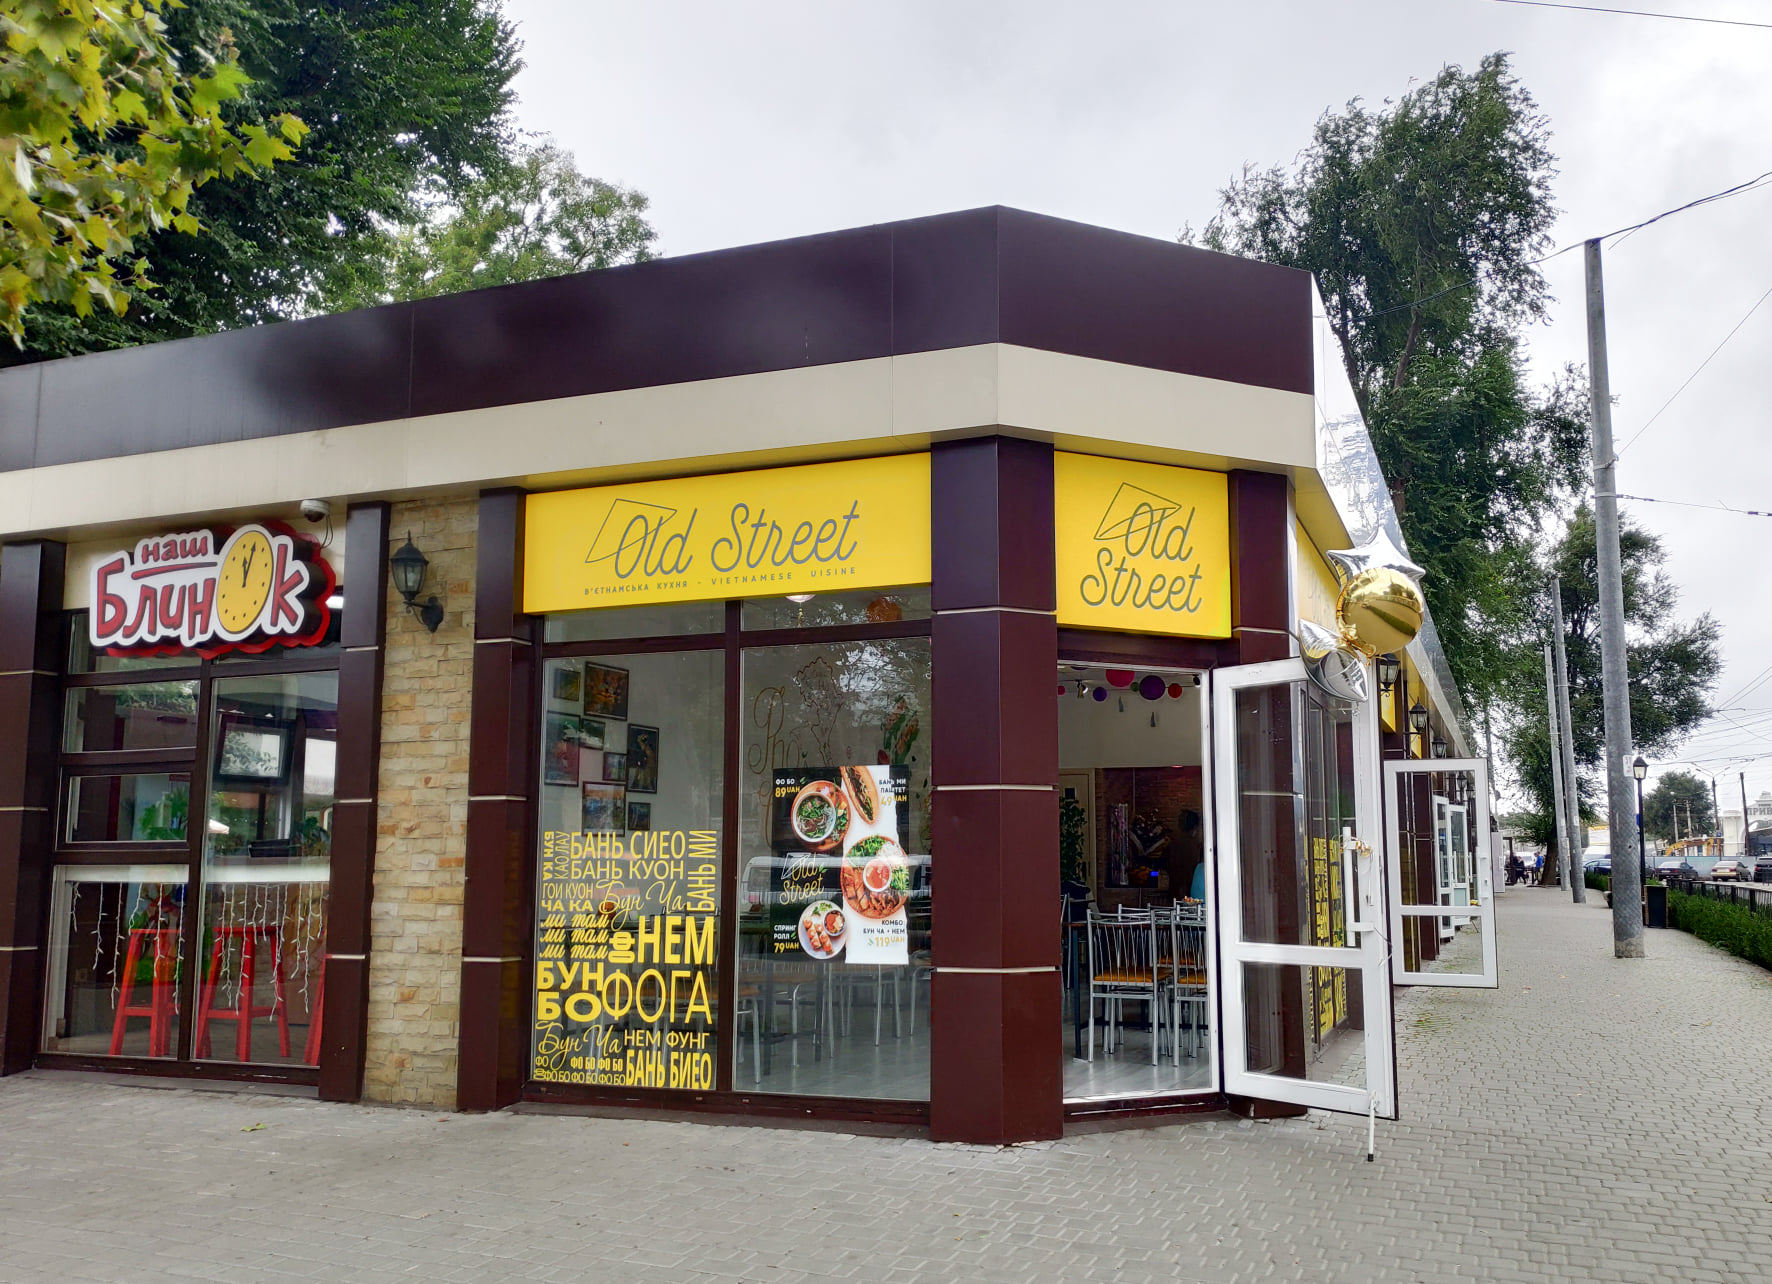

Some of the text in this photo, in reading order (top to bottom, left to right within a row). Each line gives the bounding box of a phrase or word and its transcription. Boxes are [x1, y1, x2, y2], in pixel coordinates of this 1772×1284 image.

[614, 500, 860, 579] Old Street
[1125, 502, 1195, 561] Old
[141, 536, 208, 563] наш
[657, 581, 688, 589] КУХНЯ
[711, 572, 792, 585] VIETNAMESE
[1080, 547, 1202, 613] Street
[543, 832, 554, 880] БУН КА
[570, 831, 685, 859] БАНЬ СИЕО
[571, 860, 684, 880] БАНЬ КУОН
[688, 830, 717, 911] БАНЬ МИ
[542, 882, 593, 900] ГОИ КУОН
[779, 873, 824, 905] Street
[541, 900, 593, 911] ЧА КА
[596, 879, 686, 931] Бун Ча
[540, 913, 610, 928] ми там
[540, 928, 609, 944] ми там
[638, 916, 715, 965] НЕМ
[539, 944, 609, 959] ми там
[537, 961, 604, 991] БУН
[537, 992, 602, 1023] БО
[602, 968, 713, 1024] ФОГА
[536, 1021, 622, 1069] Бун Ча
[624, 1029, 710, 1049] НЕМ ФУНГ
[535, 1056, 623, 1071] ФО ФО БО ФО БО
[627, 1050, 712, 1090] БАНЬ БИЕО
